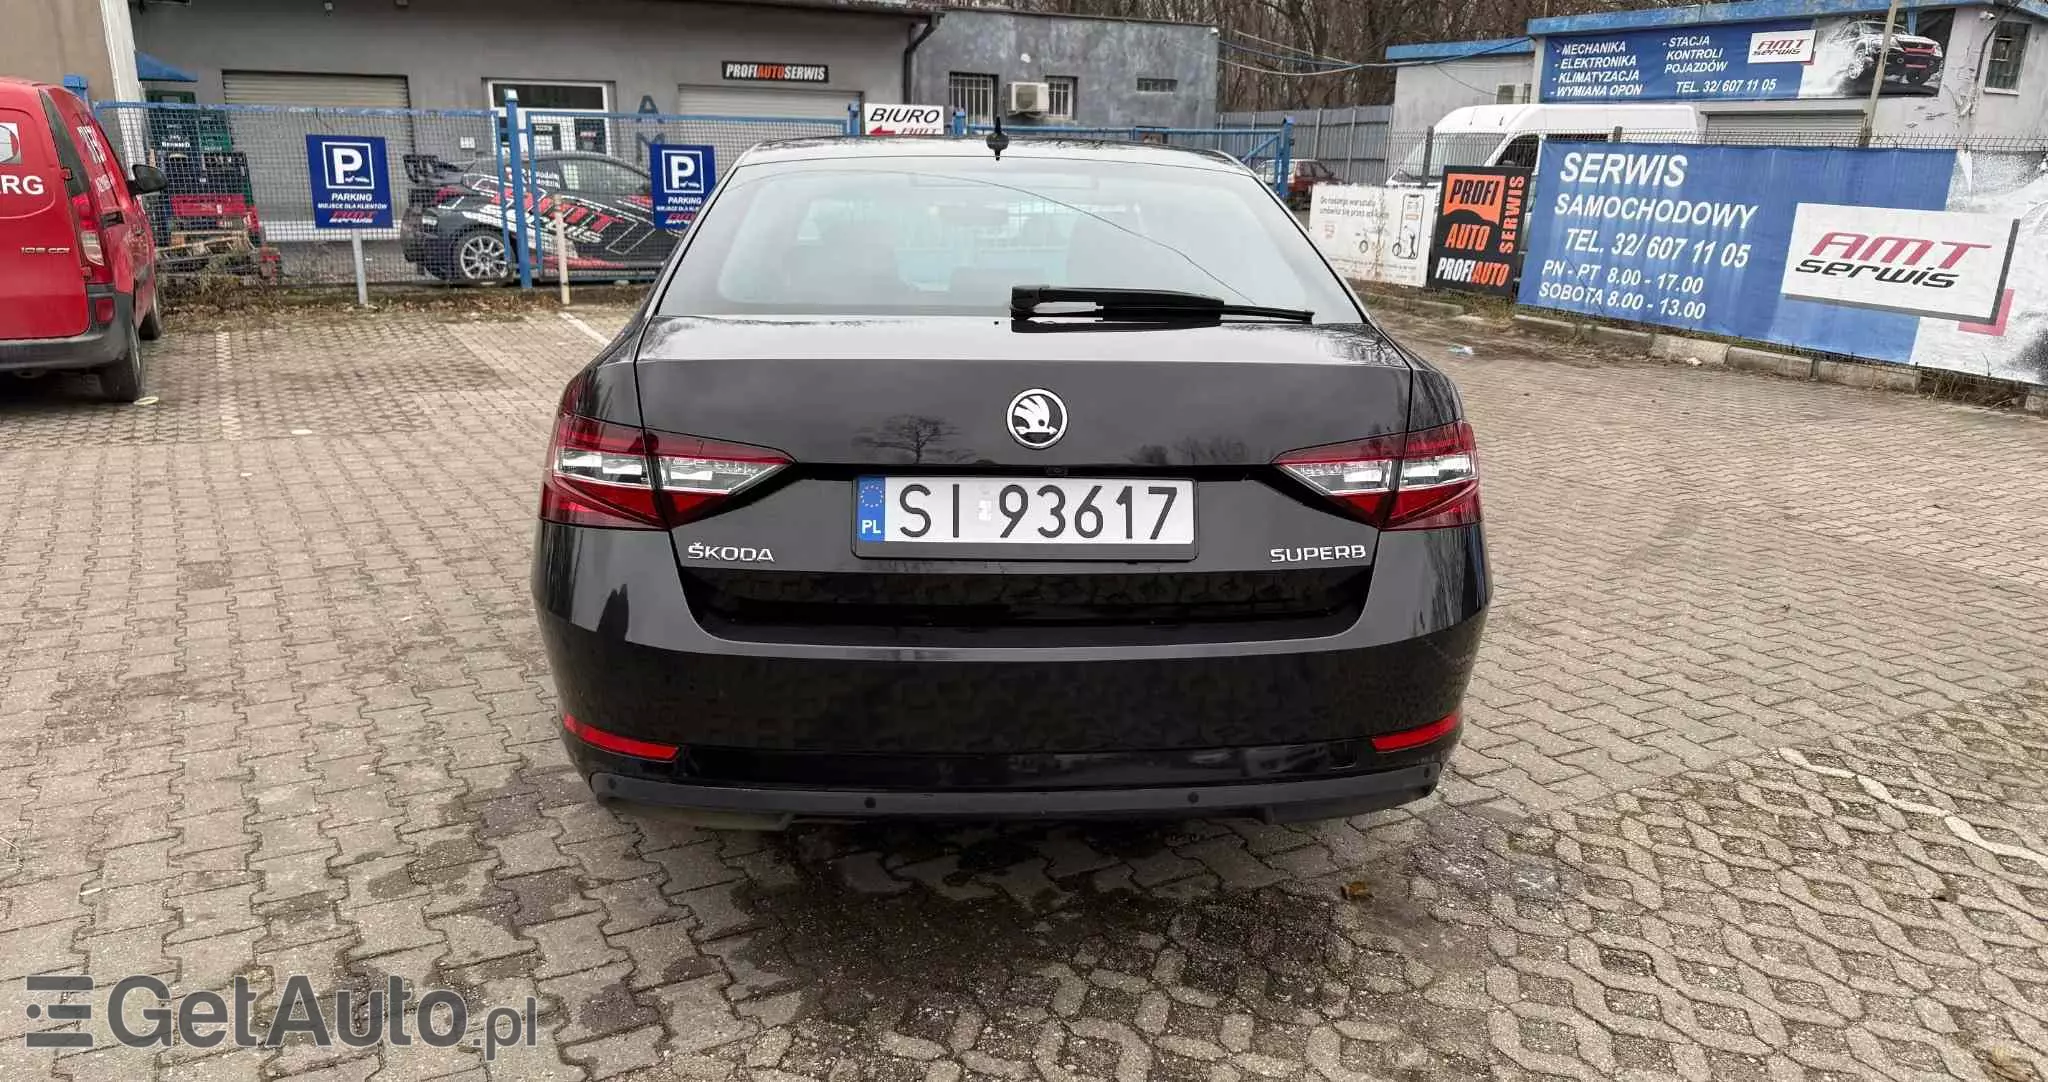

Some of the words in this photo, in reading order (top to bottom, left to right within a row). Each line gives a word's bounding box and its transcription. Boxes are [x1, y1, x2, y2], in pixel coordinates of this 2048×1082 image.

[1562, 41, 1626, 55] MECHANIKA
[1669, 35, 1710, 48] STACJA
[1757, 38, 1810, 50] AMT
[1560, 55, 1637, 69] ELEKTRONIKA
[1666, 48, 1723, 61] KONTROLI
[1558, 70, 1640, 84] KLIMATYZACJA
[1664, 61, 1728, 74] POJAZDÓW
[1556, 85, 1607, 97] WYMIANA
[1609, 84, 1643, 96] OPON
[1675, 81, 1699, 94] TEL.
[1702, 79, 1722, 93] 32/
[1722, 79, 1744, 91] 607
[1746, 79, 1759, 91] 11
[1762, 78, 1777, 90] 05
[869, 107, 940, 124] BIURO
[333, 148, 363, 184] P
[670, 155, 695, 189] P
[1560, 152, 1688, 188] SERWIS
[0, 174, 44, 195] RG
[1448, 179, 1500, 206] PROFI
[331, 192, 372, 202] PARKING
[668, 196, 702, 204] PARKING
[1499, 175, 1525, 254] SERWIS
[1554, 193, 1759, 229] SAMOCHODOWY
[1444, 223, 1491, 252] AUTO
[1565, 228, 1604, 254] TEL.
[1611, 232, 1645, 257] 32/
[1646, 235, 1688, 260] 607
[1692, 240, 1717, 265] 11
[1720, 243, 1752, 268] 05
[1809, 232, 1992, 270] AMT
[1435, 257, 1510, 287] PROFIAUTO
[1541, 259, 1566, 277] PN
[1576, 263, 1602, 282] PT
[1607, 267, 1642, 286] 8.00
[1657, 272, 1704, 295] 17.00
[1795, 259, 1960, 289] serwis
[1539, 281, 1603, 305] SOBOTA
[1607, 290, 1644, 310] 8.00
[1659, 297, 1706, 320] 13.00
[899, 483, 960, 539] SI
[999, 484, 1178, 540] 93617
[862, 519, 882, 534] PL
[687, 542, 775, 562] ŠKODA
[1270, 544, 1366, 563] SUPERB
